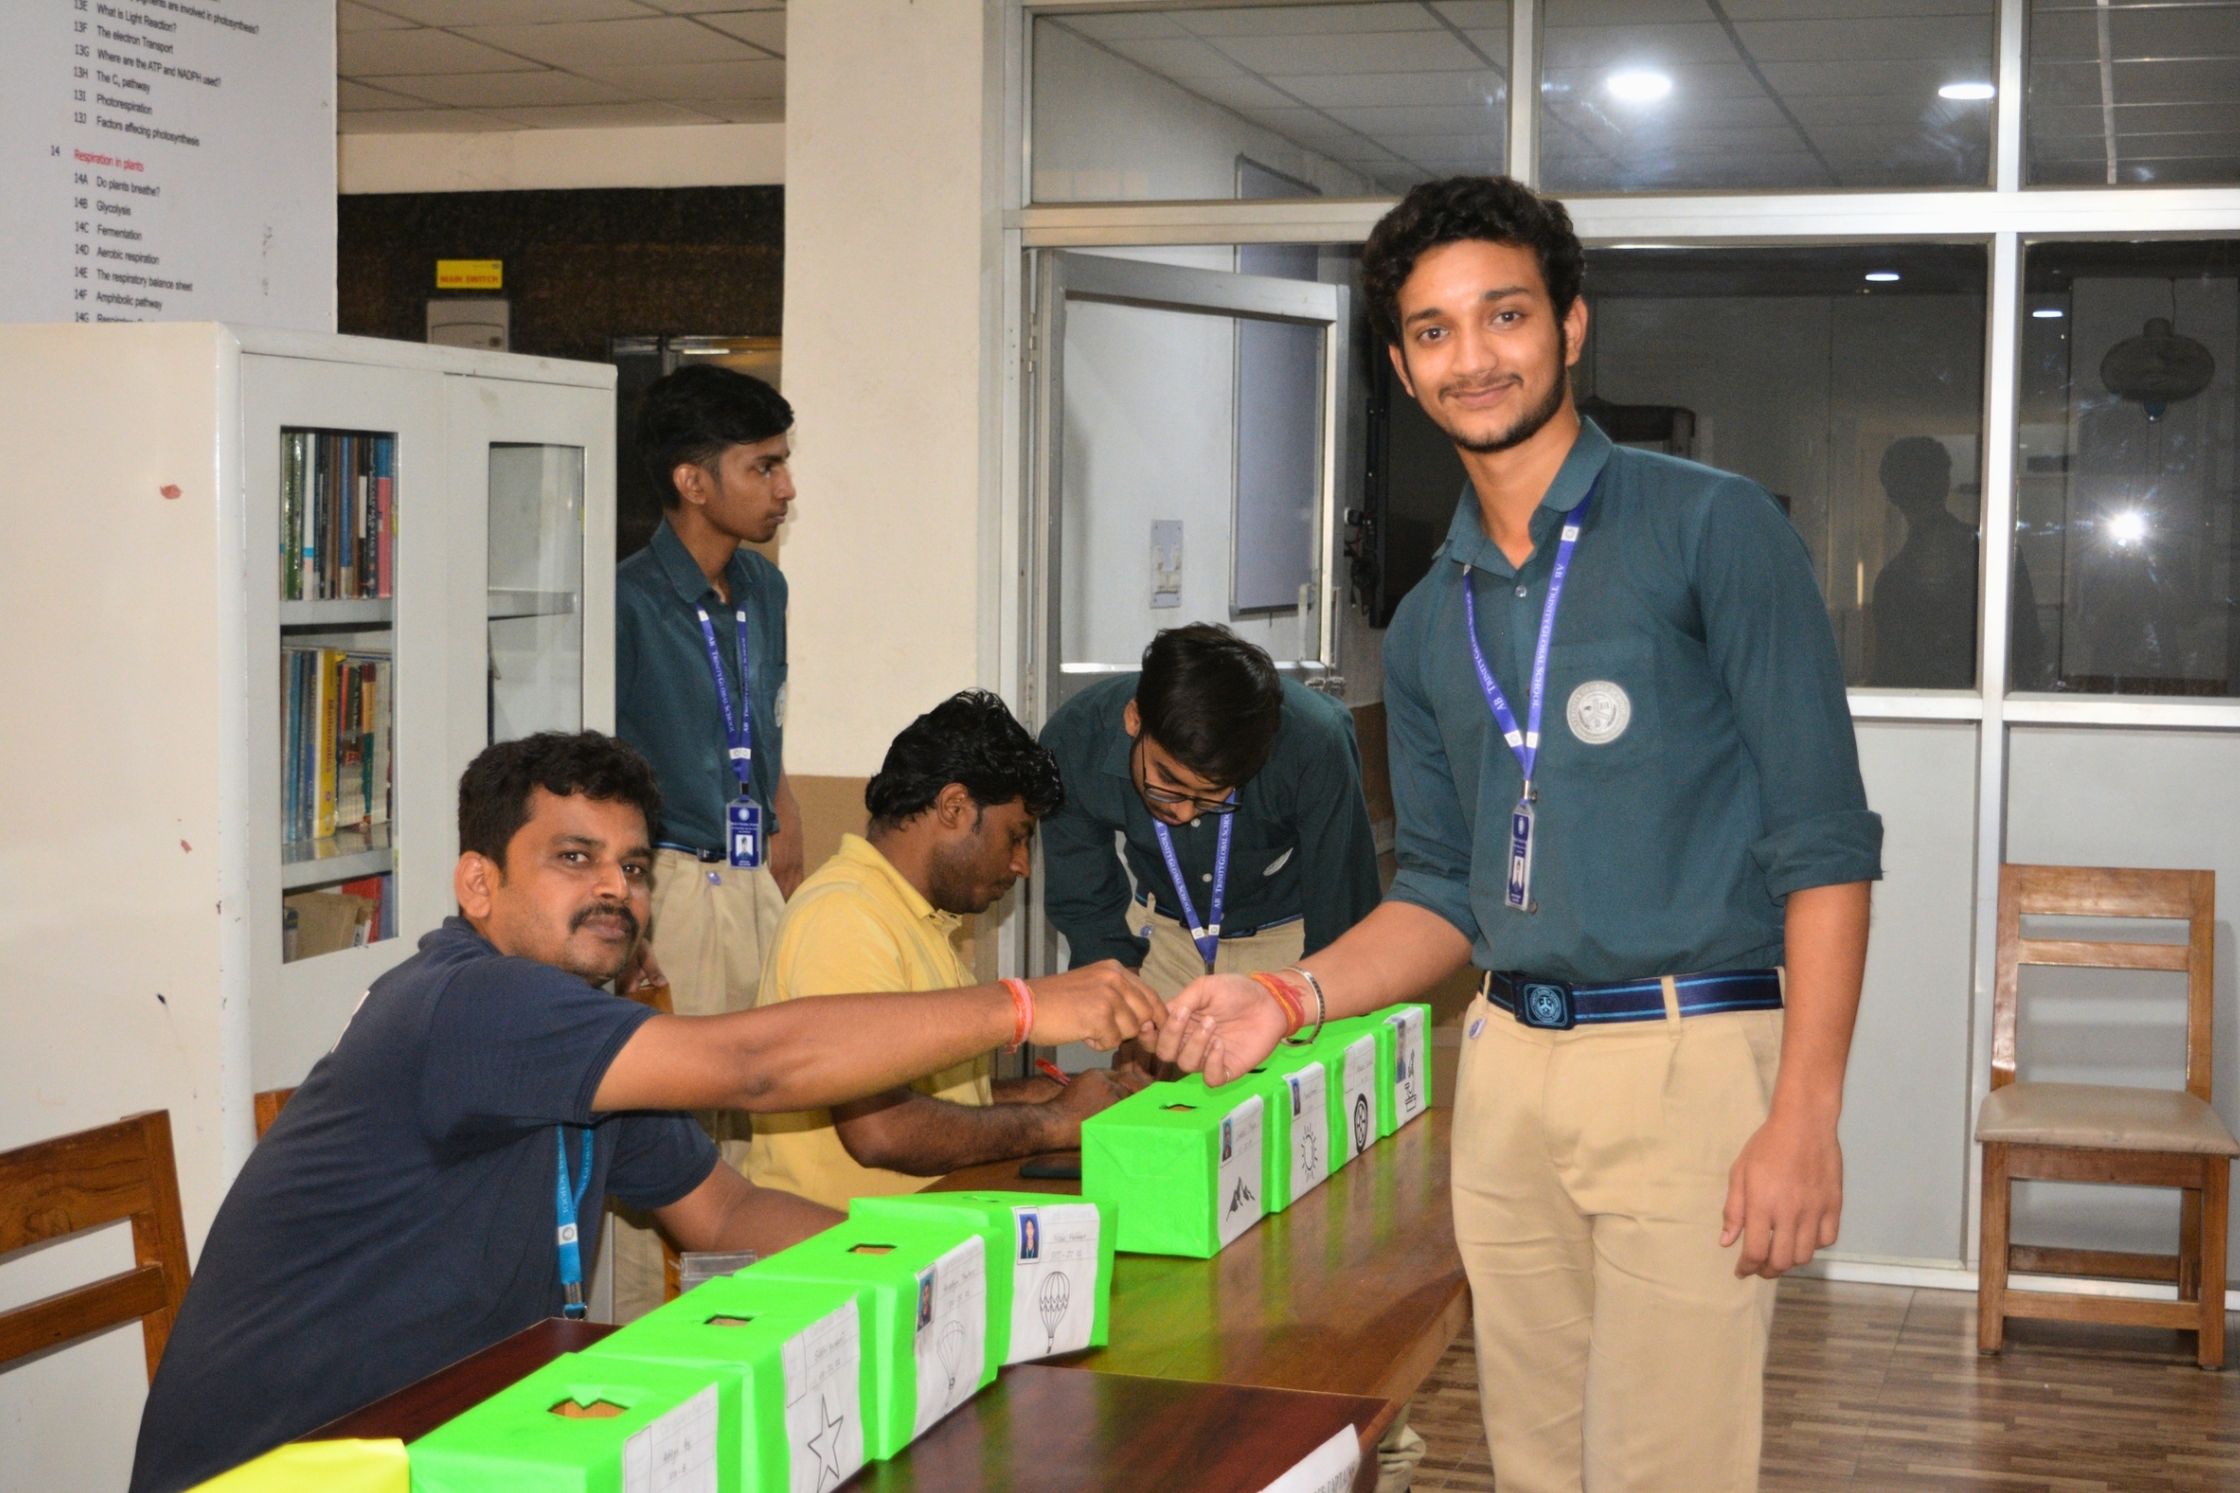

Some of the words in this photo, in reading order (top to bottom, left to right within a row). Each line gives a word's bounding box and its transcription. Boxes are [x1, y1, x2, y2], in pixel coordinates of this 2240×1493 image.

[97, 2, 116, 17] What
[125, 9, 143, 25] Light
[97, 24, 111, 38] The
[113, 30, 141, 45] electron
[142, 35, 174, 53] Transport
[97, 48, 121, 63] Where
[122, 56, 134, 67] are
[135, 57, 147, 70] the
[147, 60, 162, 73] ATP
[163, 65, 176, 77] and
[96, 70, 111, 83] The
[96, 115, 123, 131] Factors
[50, 144, 61, 157] 14
[74, 148, 113, 166] Respiration
[114, 156, 122, 168] in
[123, 159, 145, 173] plants
[74, 171, 88, 185] 14A
[96, 175, 107, 189] Do
[108, 179, 129, 192] plants
[96, 200, 131, 217] Glycolysis
[75, 221, 90, 234] 14C
[97, 224, 143, 241] Fermentation
[124, 251, 160, 265] respiration
[96, 268, 110, 281] The
[111, 273, 147, 288] respiratory
[148, 277, 174, 290] balance
[1493, 696, 1507, 710] AB
